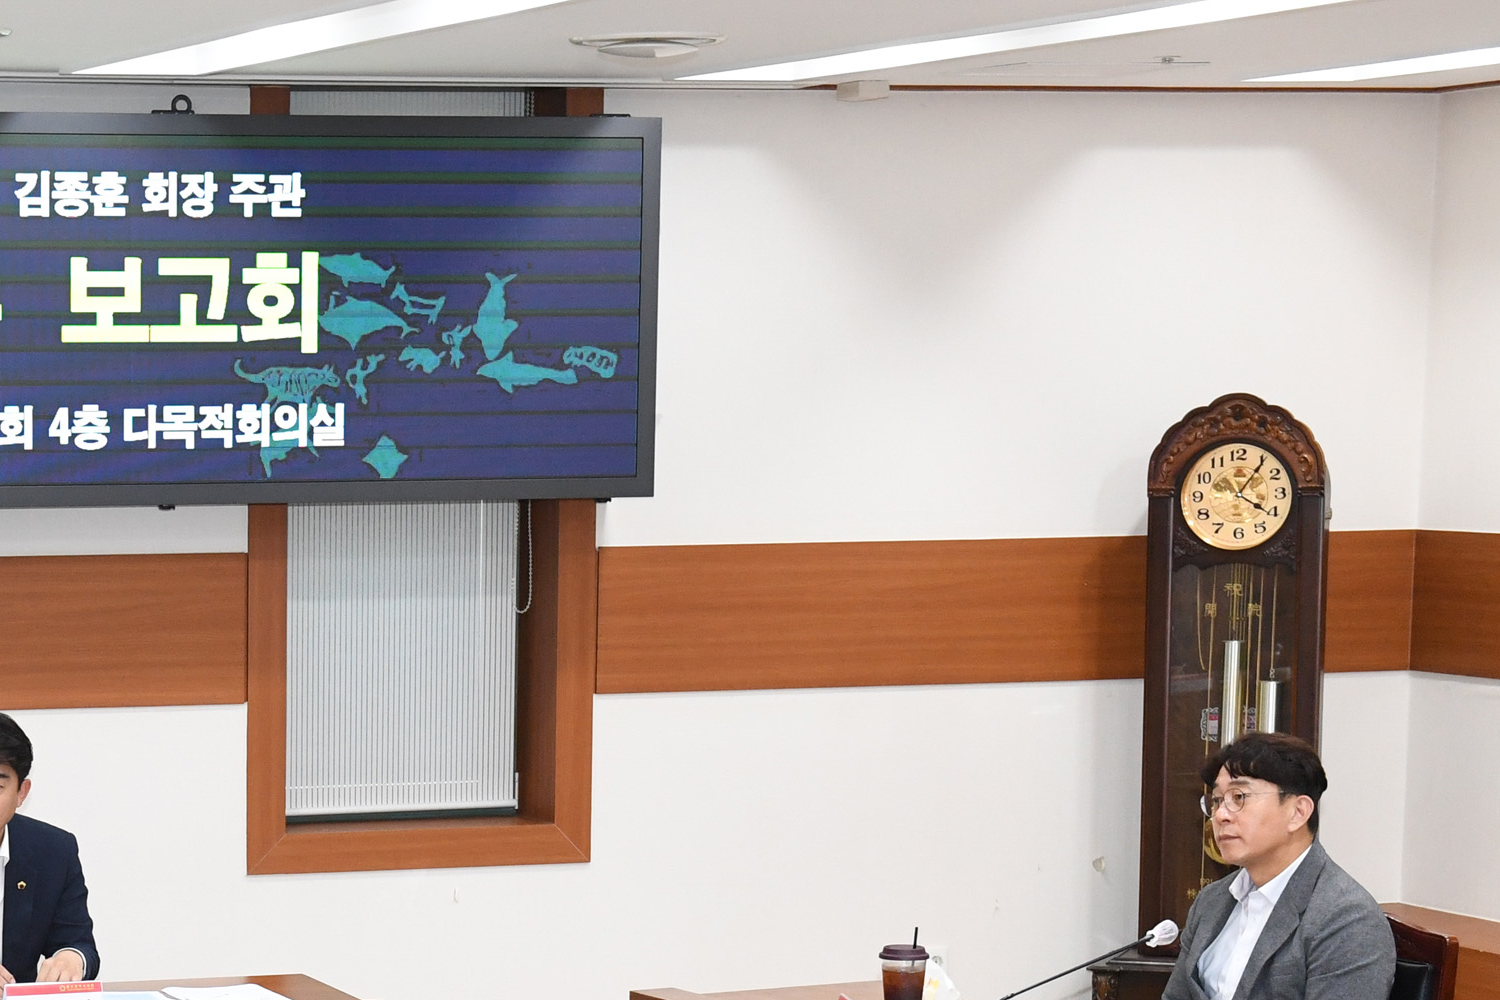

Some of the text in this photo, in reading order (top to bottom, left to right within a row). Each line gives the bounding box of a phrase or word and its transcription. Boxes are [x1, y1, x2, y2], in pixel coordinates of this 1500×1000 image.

[14, 171, 129, 217] 김종훈
[142, 172, 217, 218] 회장
[229, 173, 305, 217] 주관
[62, 252, 320, 353] 보고회
[49, 404, 110, 450] 4층
[124, 403, 345, 449] 다목적회의실
[1211, 453, 1225, 468] 11
[1230, 448, 1247, 461] 12
[1197, 471, 1212, 484] 10
[1269, 468, 1281, 480] 2
[1192, 491, 1204, 503] 9
[1274, 486, 1287, 499] 3
[1197, 508, 1210, 521] 8
[1266, 505, 1280, 517] 4
[1212, 522, 1224, 534] 7
[1233, 528, 1245, 540] 6
[1254, 521, 1267, 534] 5
